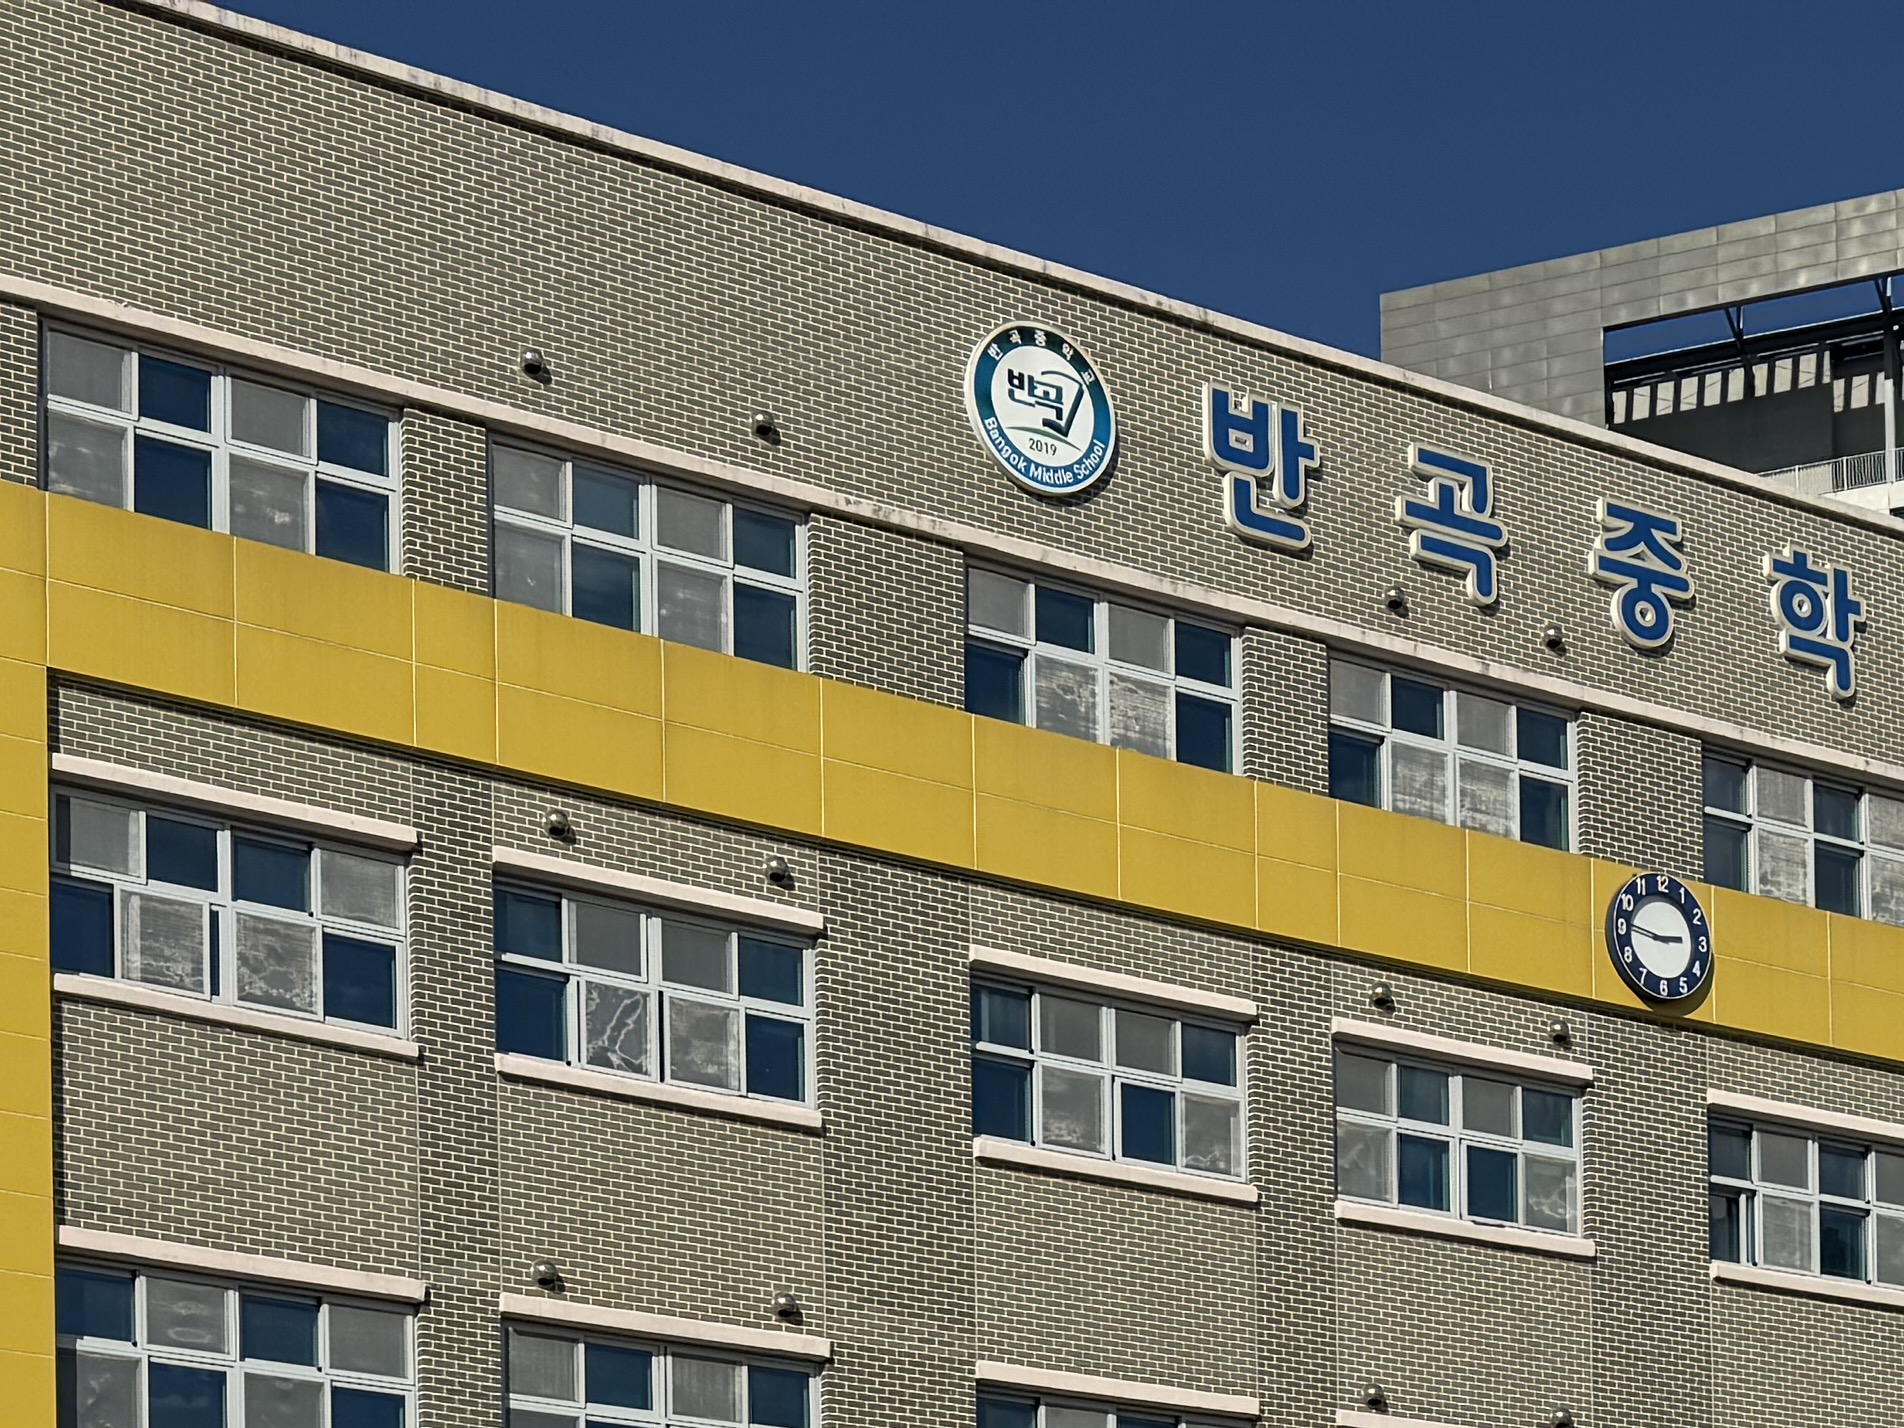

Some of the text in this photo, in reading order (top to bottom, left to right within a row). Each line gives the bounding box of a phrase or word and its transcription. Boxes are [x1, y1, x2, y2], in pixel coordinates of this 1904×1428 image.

[984, 416, 1106, 485] Bangok Middle School
[1028, 437, 1057, 457] 2019
[1636, 877, 1646, 896] 11
[1657, 876, 1669, 893] 12
[1621, 894, 1634, 911] 10
[1680, 887, 1685, 904] 1
[1693, 908, 1702, 925] 2
[1618, 918, 1627, 935] 9
[1698, 936, 1707, 952] 3
[1624, 946, 1633, 963] 8
[1639, 968, 1648, 984] 7
[1692, 961, 1701, 978] 4
[1660, 980, 1668, 996] 6
[1679, 977, 1688, 994] 5
